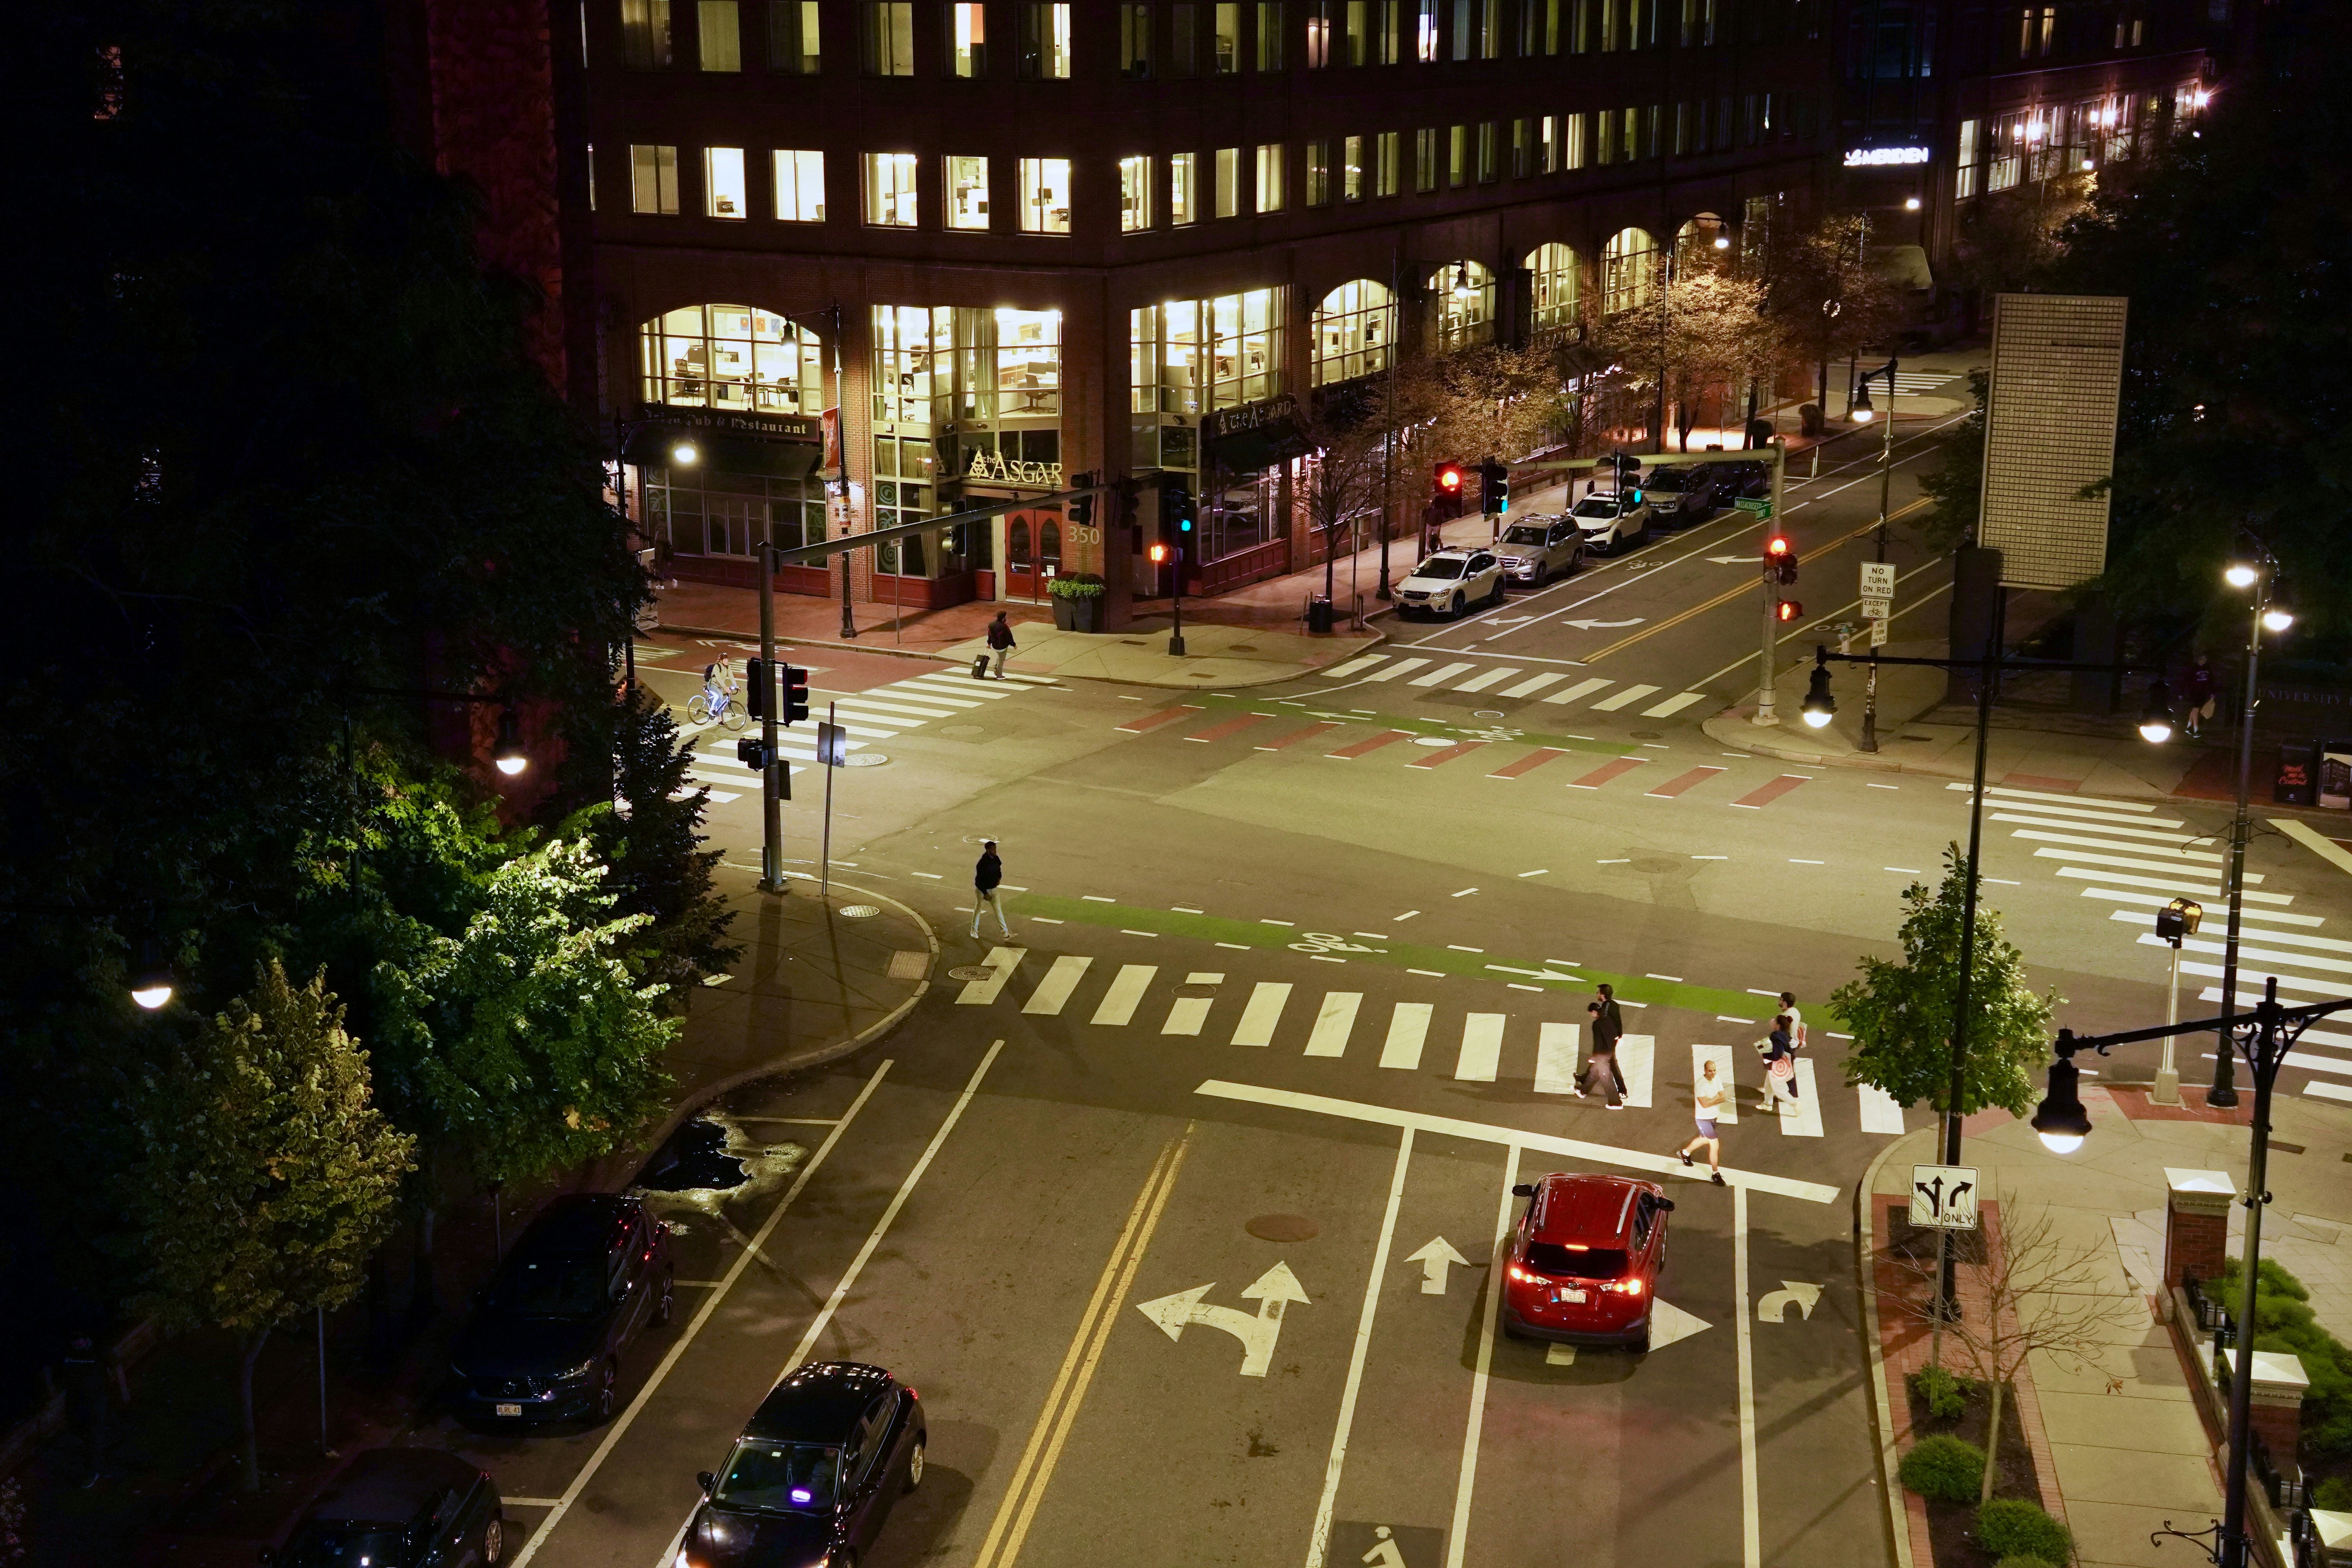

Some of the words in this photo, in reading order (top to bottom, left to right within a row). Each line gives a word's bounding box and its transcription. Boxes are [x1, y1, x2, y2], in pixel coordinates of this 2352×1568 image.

[731, 417, 806, 434] Restaurant
[1068, 526, 1100, 545] 350
[1944, 1213, 1973, 1223] ONLY
